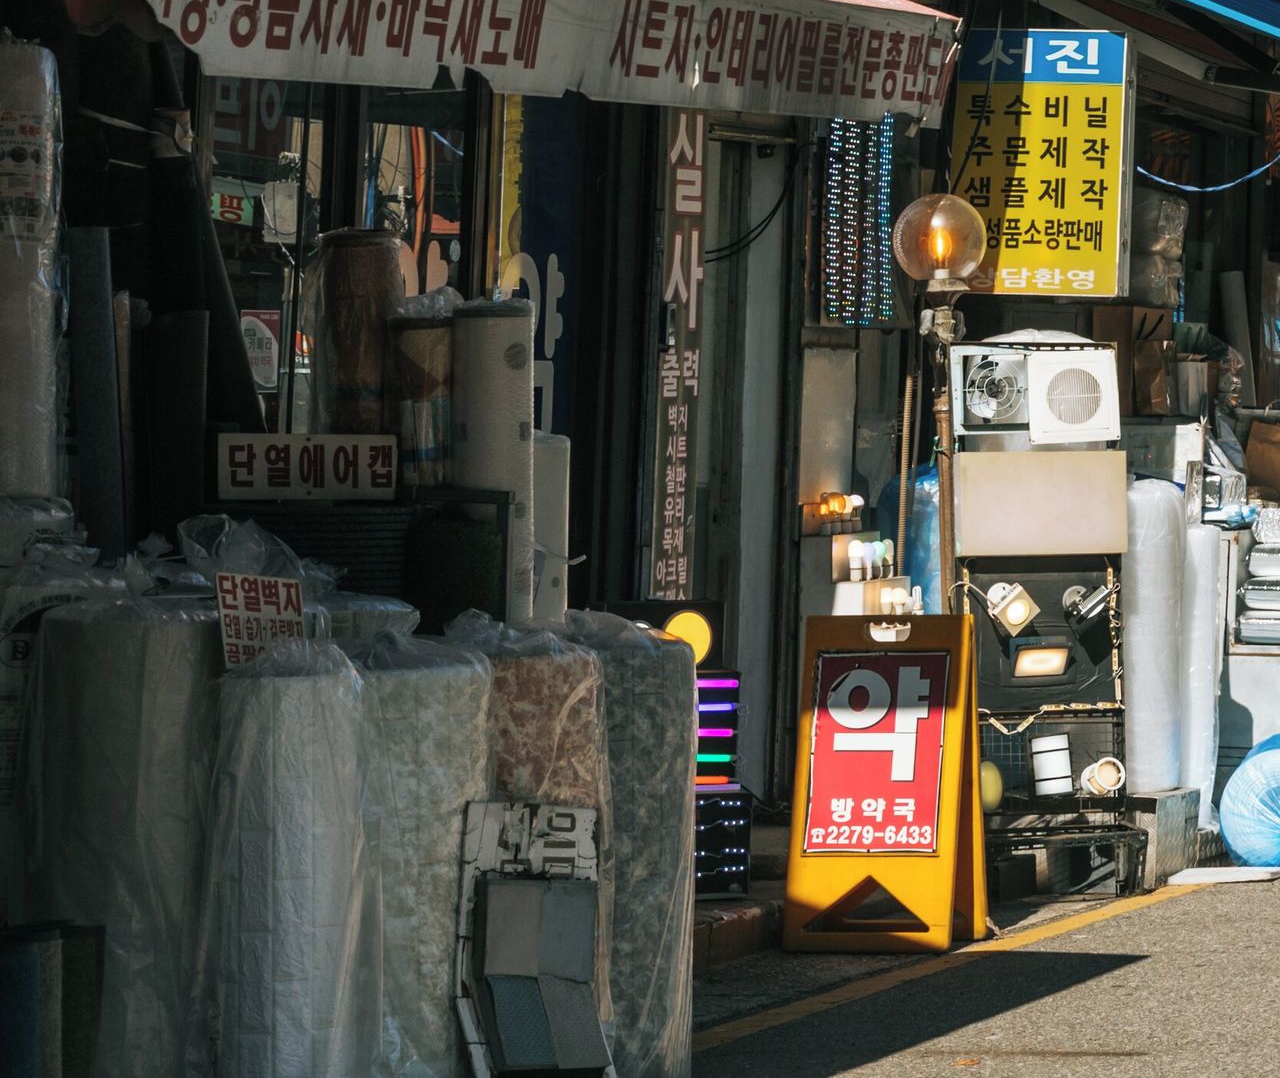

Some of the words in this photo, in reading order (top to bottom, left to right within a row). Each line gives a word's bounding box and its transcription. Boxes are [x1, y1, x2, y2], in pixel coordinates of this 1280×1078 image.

[977, 37, 1101, 75] 서진
[966, 94, 1109, 130] 특수비닐
[967, 134, 1109, 168] 주문제작
[964, 175, 1109, 210] 샘플제작
[663, 112, 704, 333] 실사
[970, 266, 1096, 290] 상담환영
[660, 347, 700, 398] 출력
[667, 404, 690, 429] 벽지
[666, 434, 690, 462] 시트
[228, 443, 394, 489] 단열에어캡
[663, 497, 687, 525] 유리
[656, 558, 688, 587] 아크릴
[218, 574, 303, 618] 단열벽지
[826, 665, 932, 782] 약
[831, 798, 917, 823] 방약국
[826, 824, 933, 848] 2279-6433
